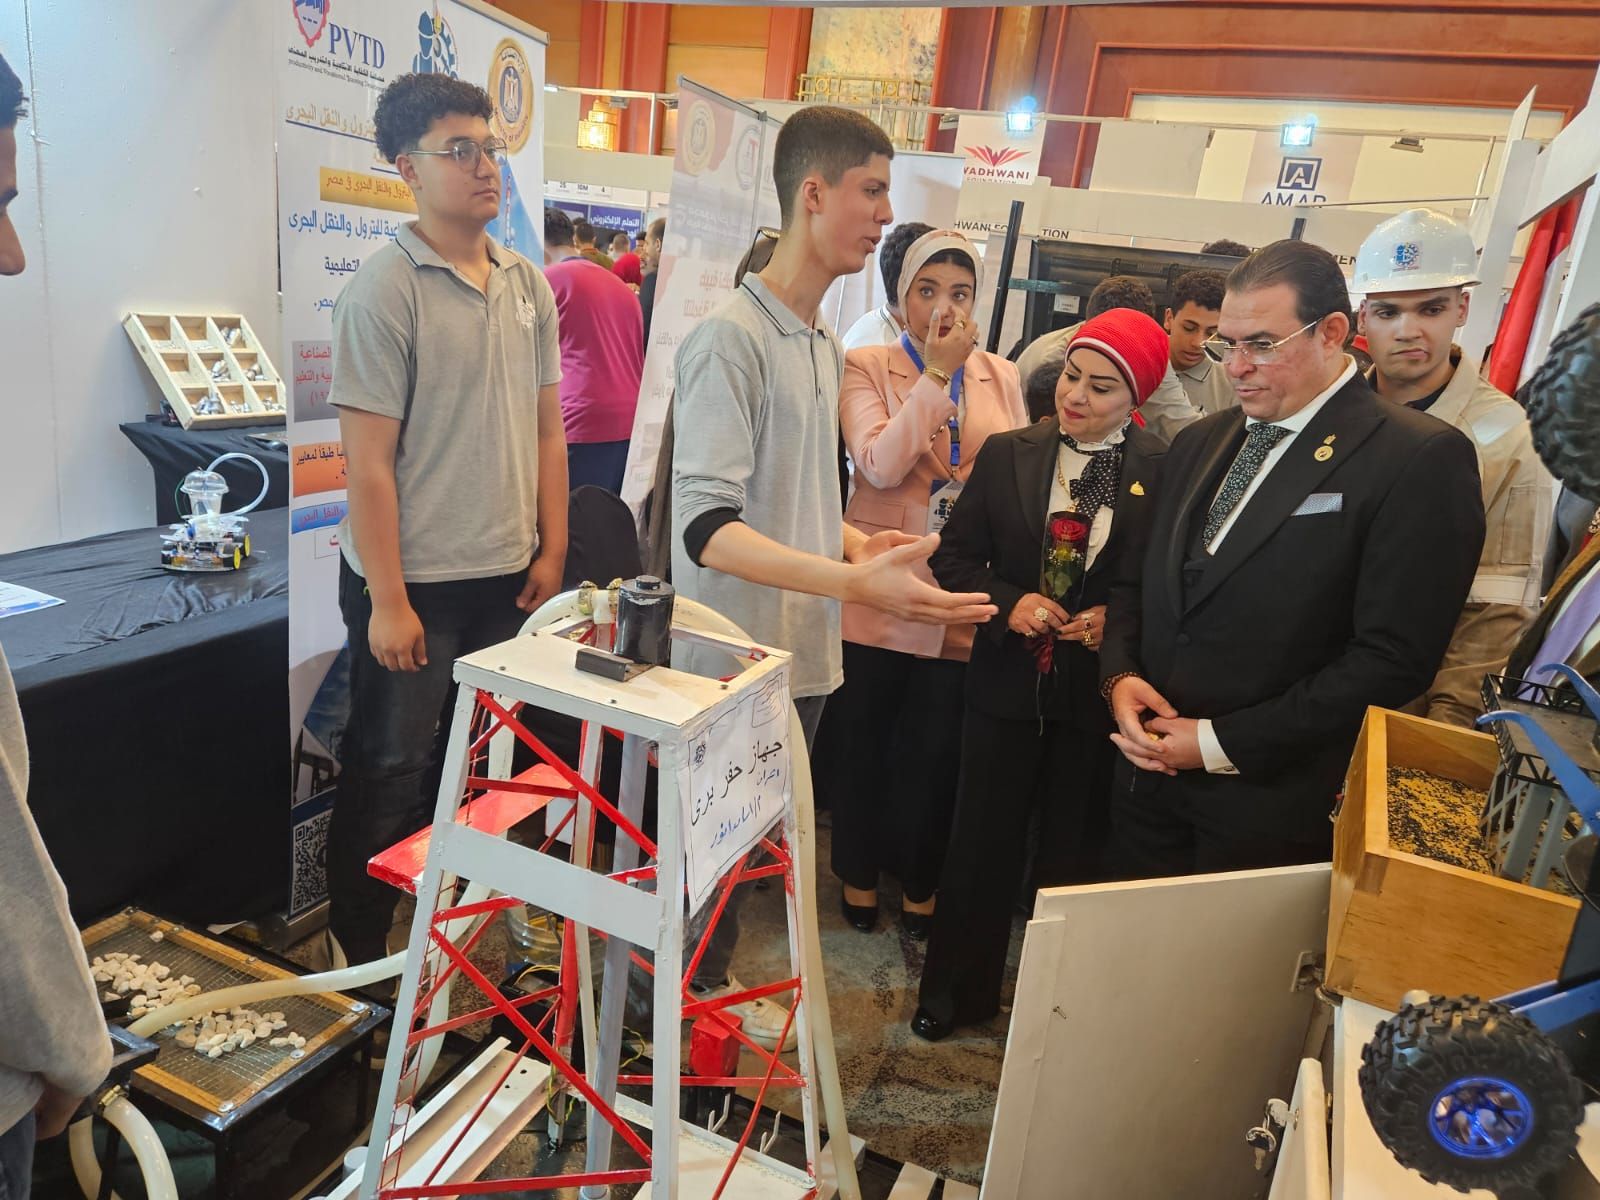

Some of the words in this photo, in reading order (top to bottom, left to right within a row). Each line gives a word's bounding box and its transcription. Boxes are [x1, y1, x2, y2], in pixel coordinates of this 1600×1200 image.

[328, 22, 385, 69] PVTD
[288, 210, 317, 232] البحرى
[320, 211, 352, 238] والنقل
[355, 216, 383, 240] للبترول
[953, 220, 990, 231] HWANI
[747, 739, 783, 775] جهاز
[720, 760, 743, 799] حفر
